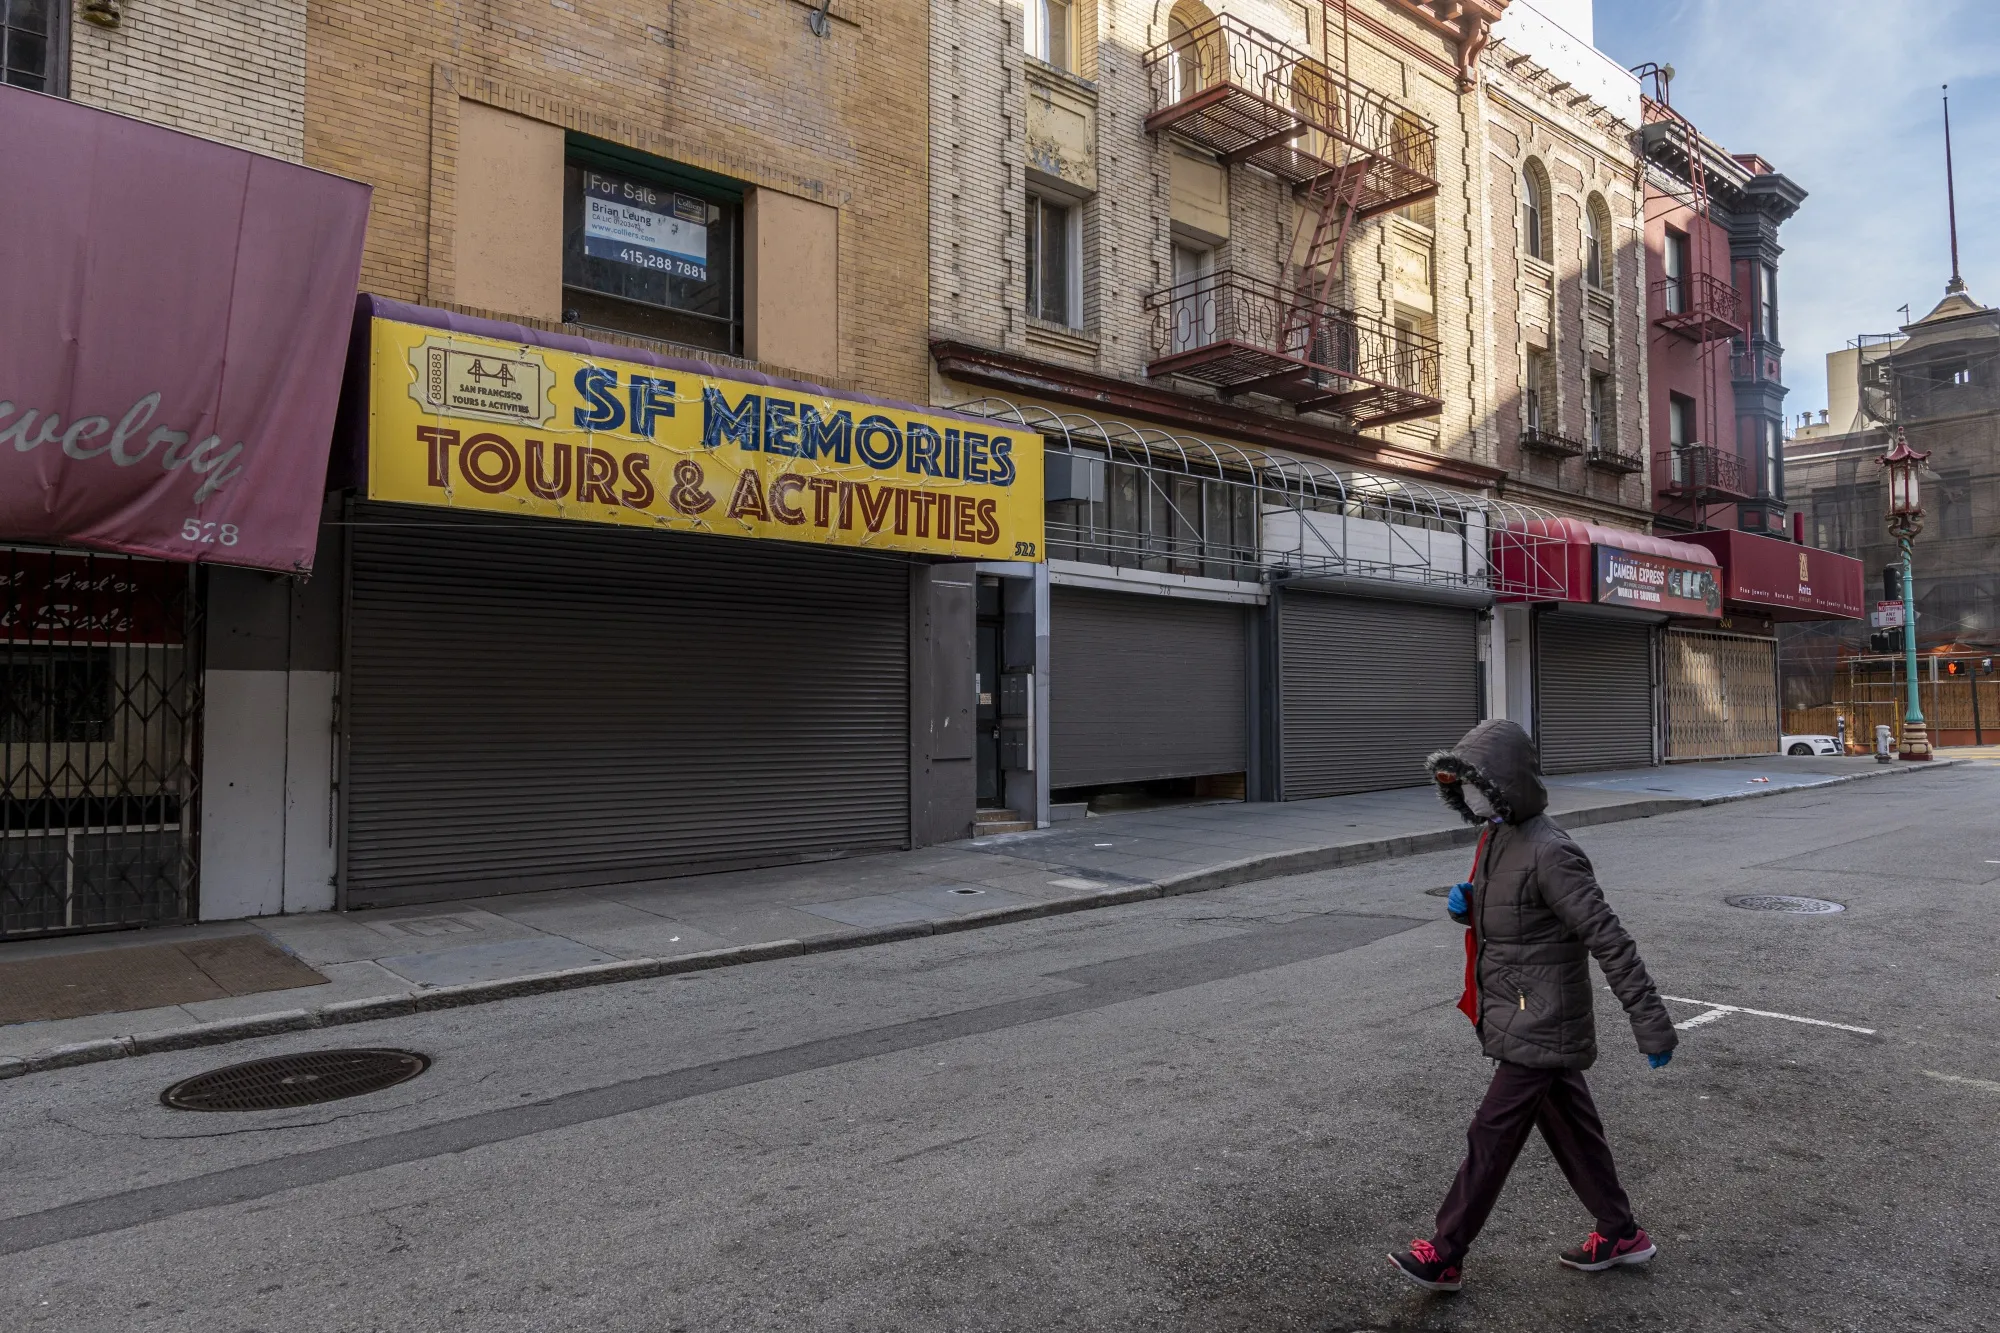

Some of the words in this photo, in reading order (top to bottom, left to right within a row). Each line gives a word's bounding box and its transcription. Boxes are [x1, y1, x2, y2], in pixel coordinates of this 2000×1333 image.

[591, 175, 618, 194] For
[624, 183, 656, 204] Sale
[592, 202, 618, 216] Brian
[622, 209, 652, 226] Leung
[592, 224, 655, 242] www.colliers.com
[620, 248, 643, 264] 415
[648, 254, 672, 270] 288
[677, 262, 704, 278] 7881
[460, 384, 476, 393] SAN
[478, 386, 522, 400] FRANCISCO
[574, 366, 676, 437] SF
[453, 395, 479, 407] TOURS
[488, 402, 529, 414] ACTIVITIES
[703, 386, 1016, 486] MEMORIES
[416, 425, 654, 509] TOURS
[668, 458, 717, 516] &
[726, 468, 1000, 545] ACTIVITIES
[1014, 541, 1036, 557] 522
[1614, 563, 1637, 581] CAMERA
[1639, 568, 1664, 585] EXPRESS
[1752, 588, 1769, 597] Jewelry
[1798, 584, 1812, 596] Anita
